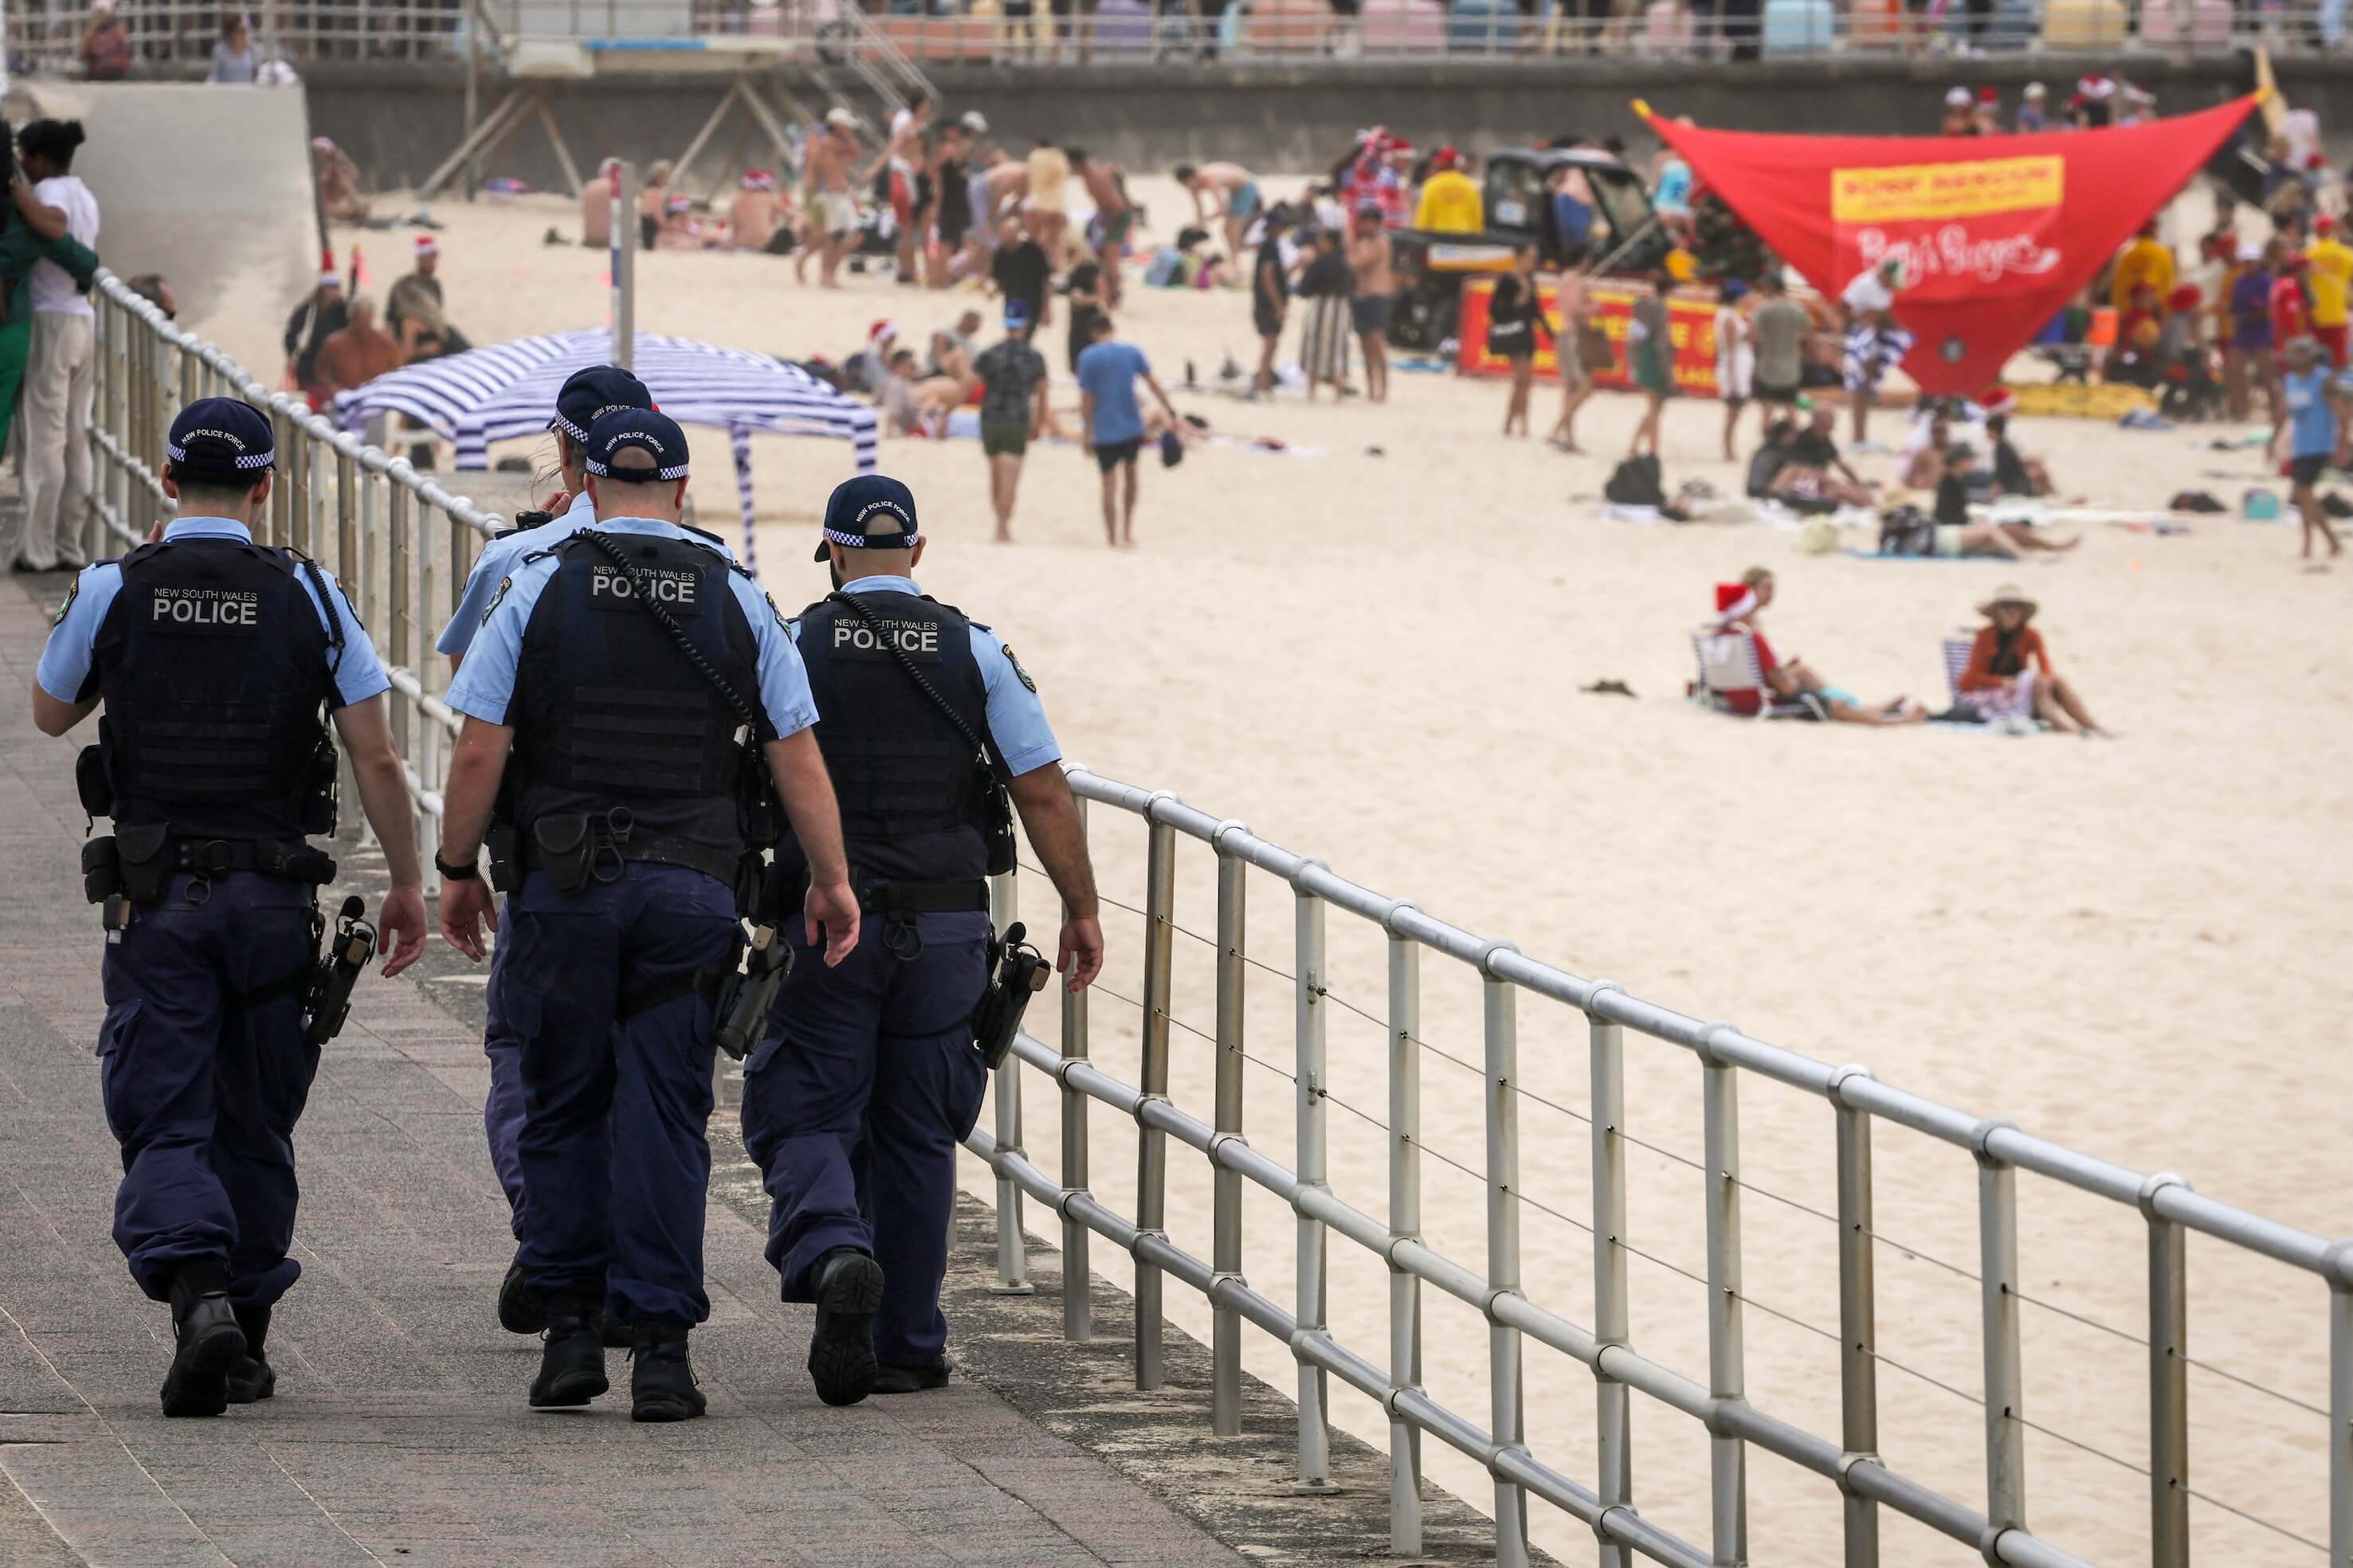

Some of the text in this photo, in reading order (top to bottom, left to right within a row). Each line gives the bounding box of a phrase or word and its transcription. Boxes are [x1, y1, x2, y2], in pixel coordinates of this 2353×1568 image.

[591, 406, 605, 421] NSW
[181, 429, 246, 452] NSW POLICE FORCE
[605, 431, 665, 453] NSW POLICE FORCE
[855, 500, 911, 523] NSW POLICE FORCE
[593, 565, 695, 582] NEW UTH WALES
[154, 588, 257, 602] NEW SOUTH WALES
[592, 574, 695, 603] POICE
[153, 598, 257, 625] POLICE
[834, 618, 938, 631] NEW STH WALES
